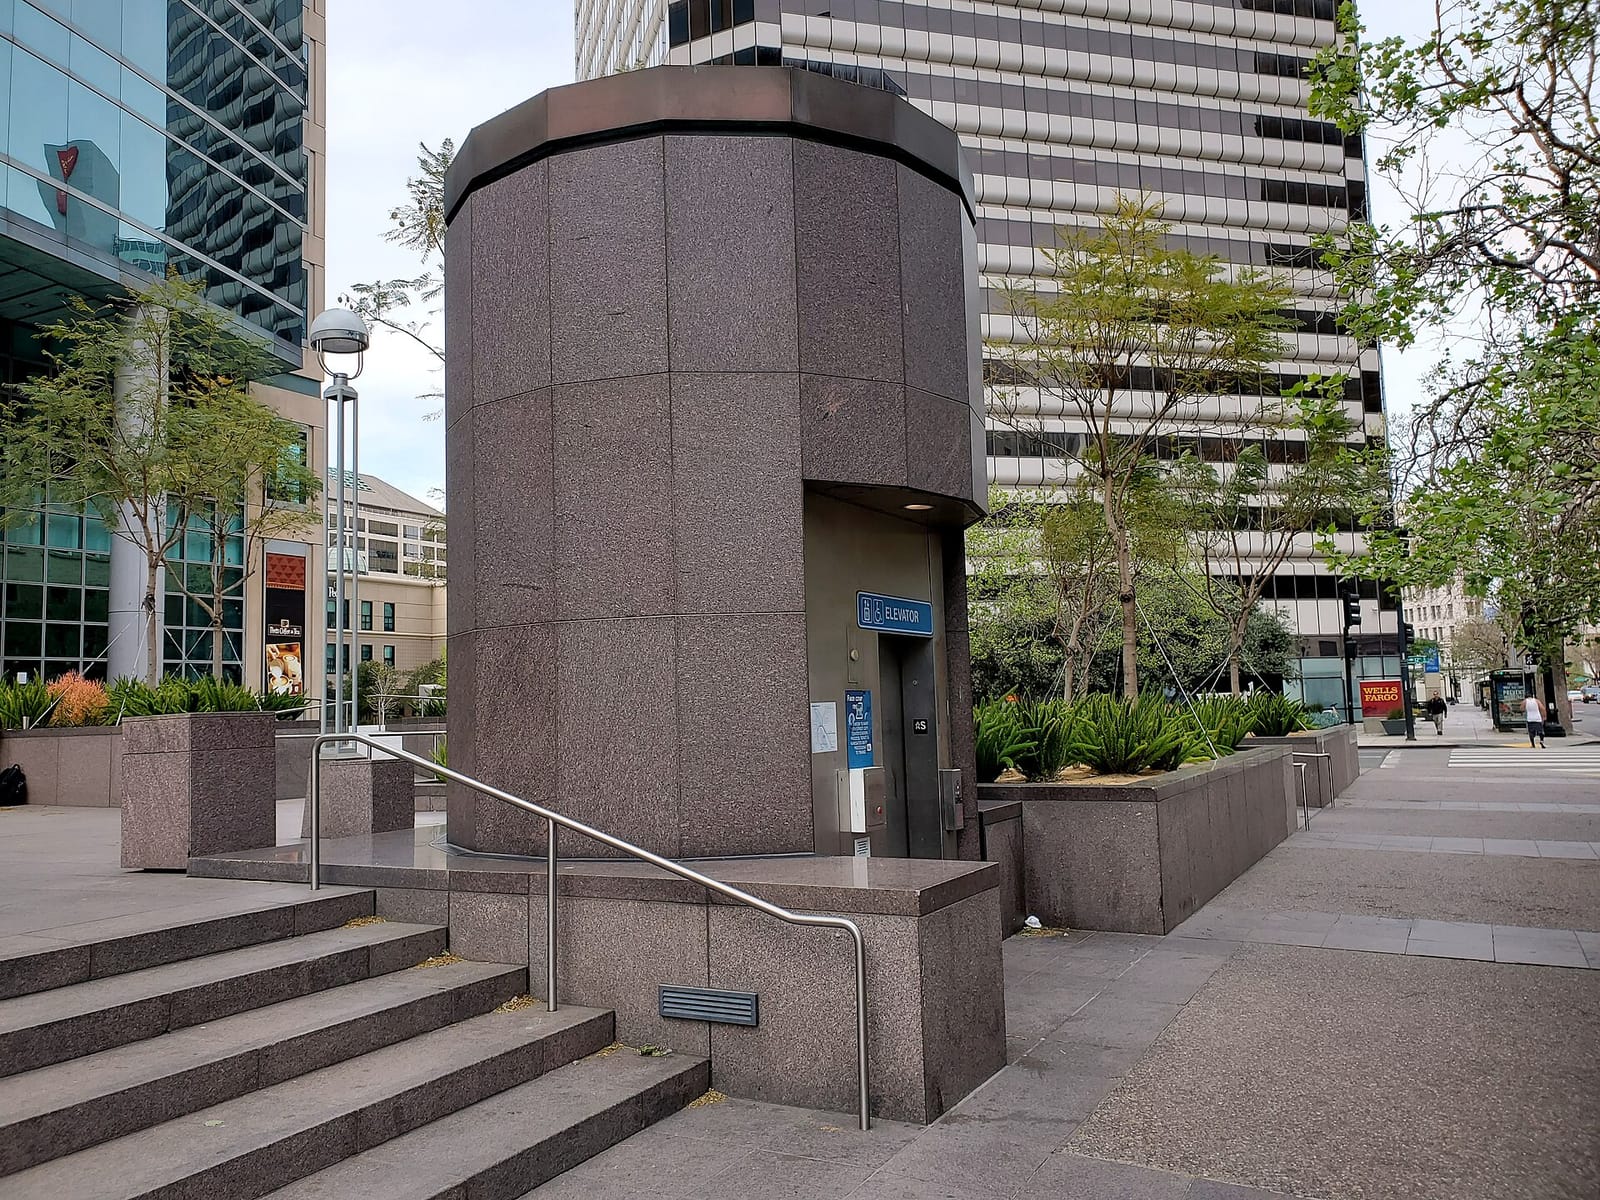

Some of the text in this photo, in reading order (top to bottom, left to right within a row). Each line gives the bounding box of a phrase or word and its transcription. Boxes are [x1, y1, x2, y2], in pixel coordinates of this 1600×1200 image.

[885, 606, 919, 623] ELEVATOR
[1363, 686, 1398, 695] WELLS
[1364, 694, 1399, 702] FARGO
